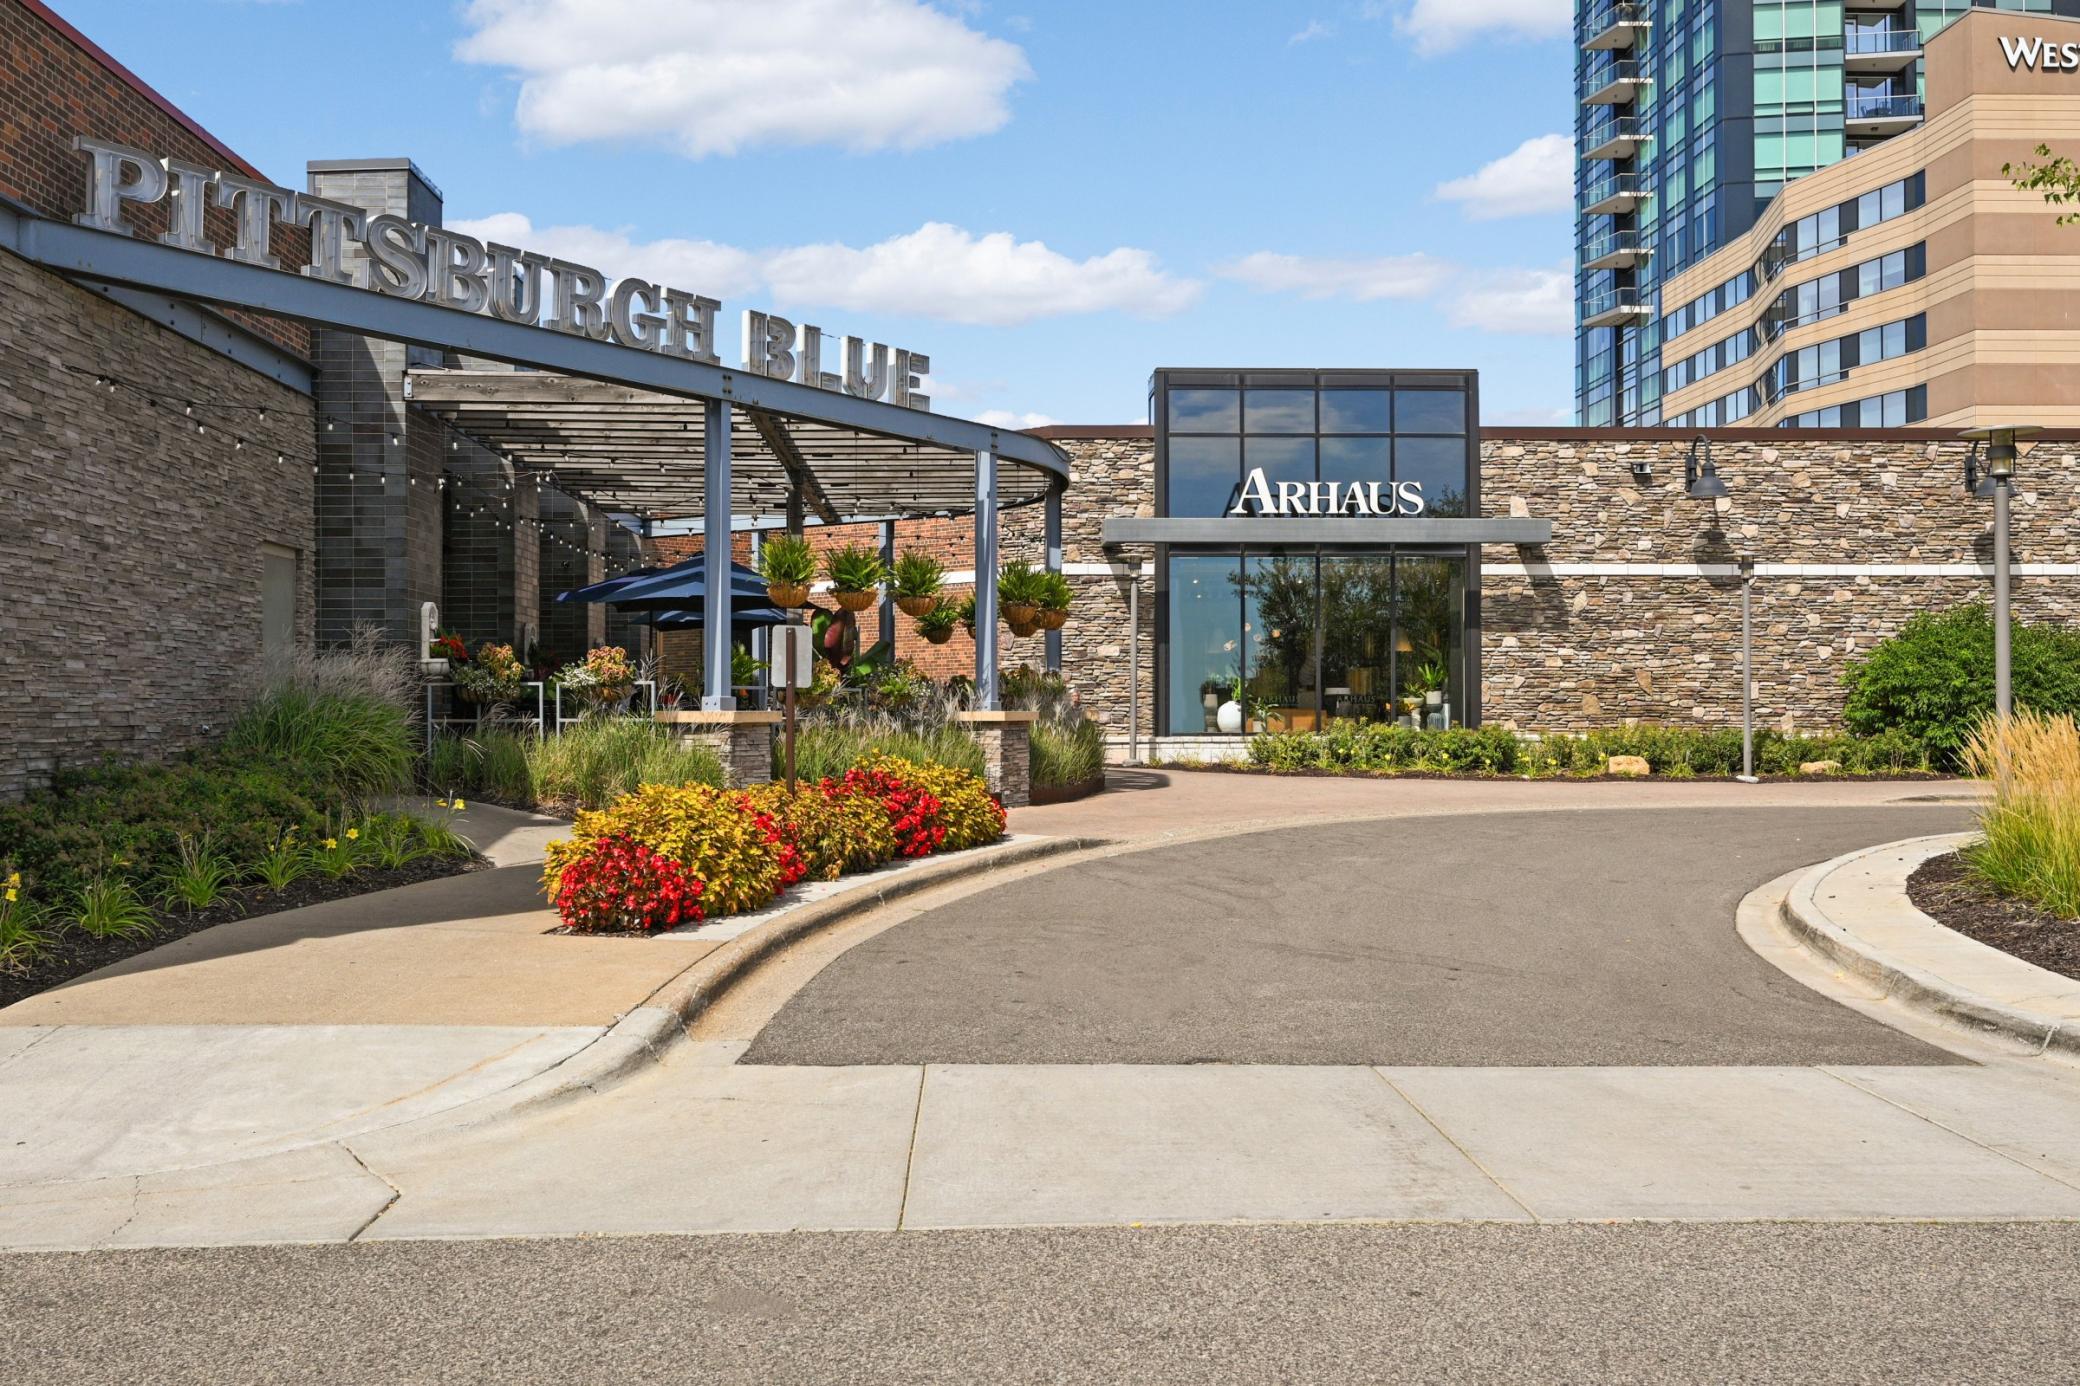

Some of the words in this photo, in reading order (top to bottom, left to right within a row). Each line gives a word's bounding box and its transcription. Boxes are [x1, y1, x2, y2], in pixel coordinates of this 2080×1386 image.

[1998, 36, 2080, 72] WES
[72, 135, 721, 367] PITTSBURGH
[741, 309, 930, 412] BLUE
[1230, 467, 1425, 515] ARHAUS
